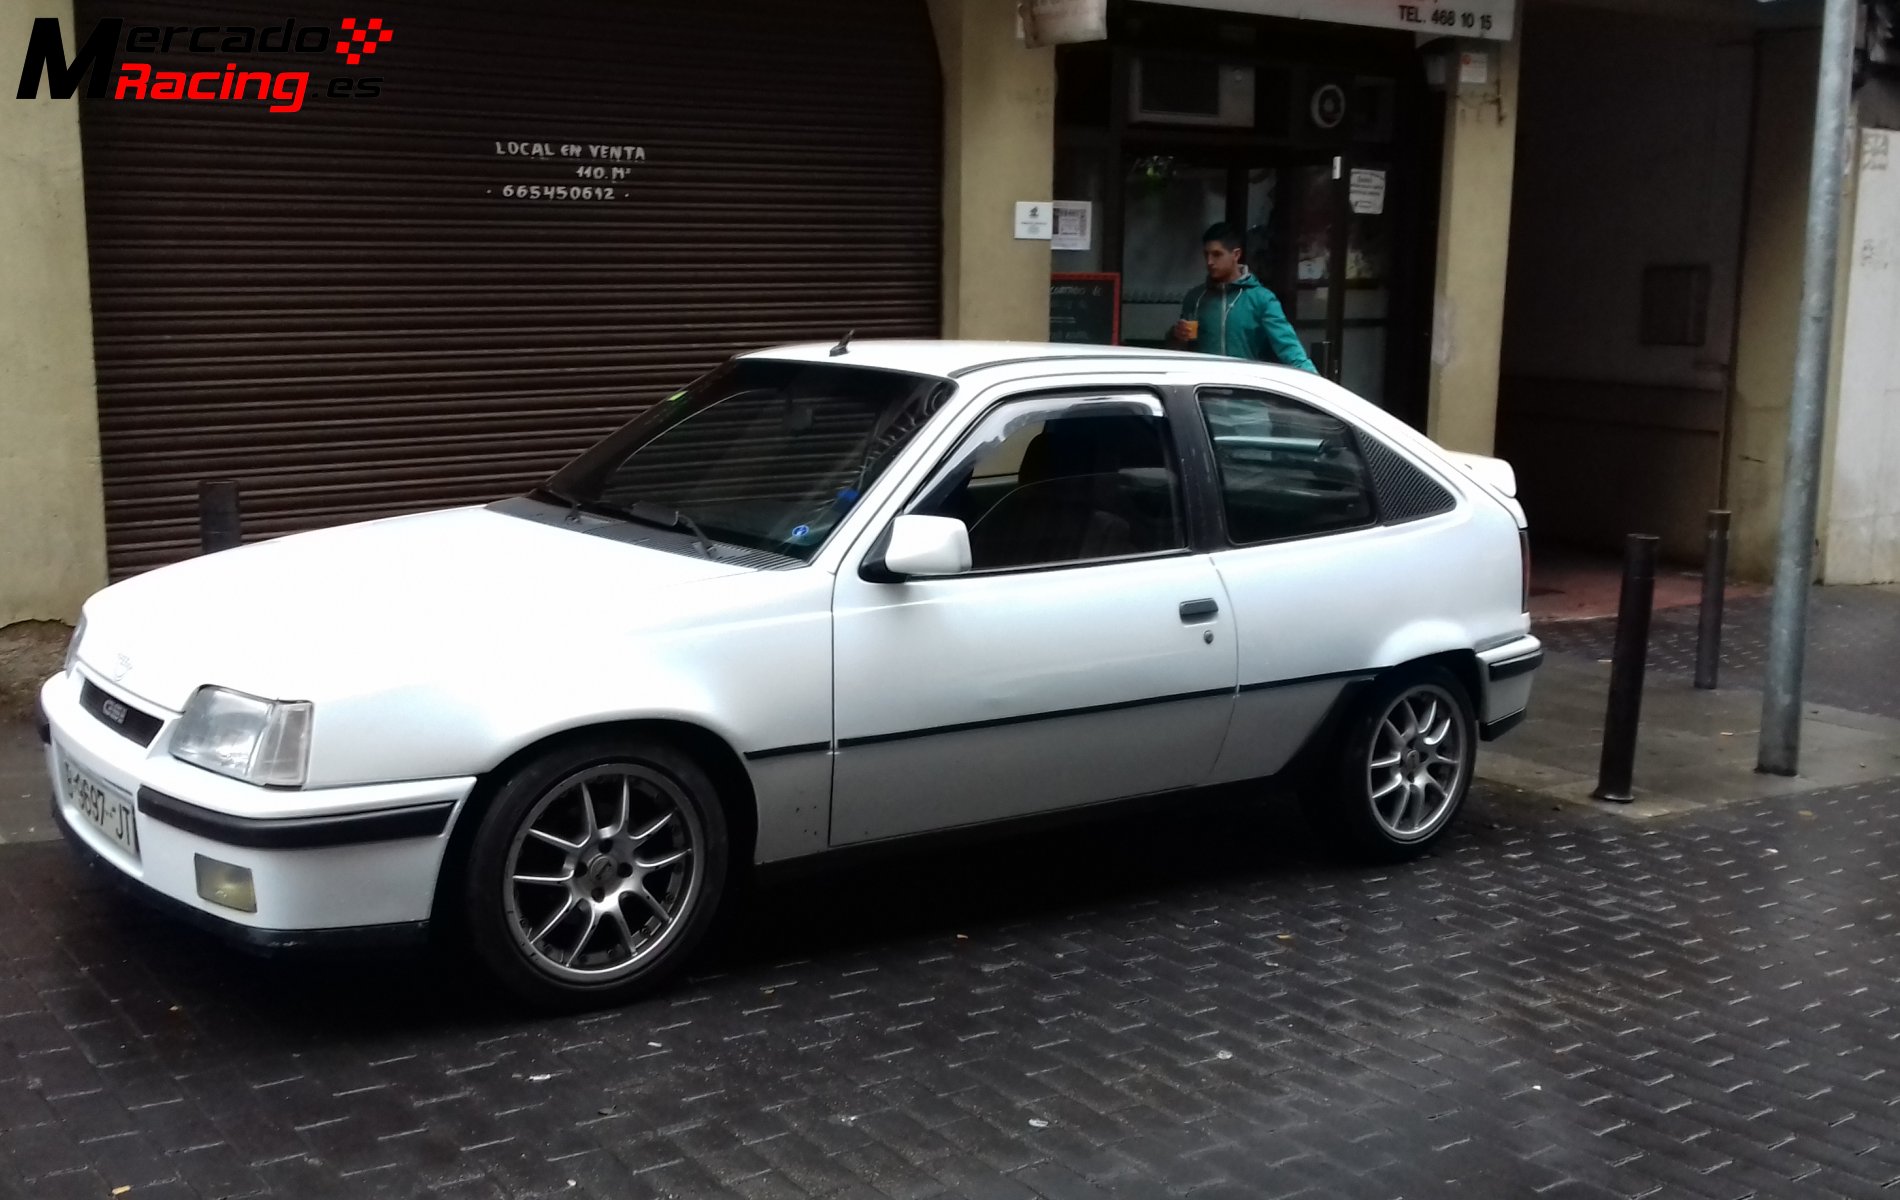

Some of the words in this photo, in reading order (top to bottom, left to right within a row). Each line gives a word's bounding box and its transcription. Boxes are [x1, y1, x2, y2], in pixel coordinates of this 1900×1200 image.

[1398, 5, 1426, 23] TEL.
[1431, 9, 1456, 26] 468
[1460, 12, 1475, 28] 10
[1479, 14, 1493, 31] 15
[495, 141, 555, 157] LOCAL
[560, 144, 582, 158] EN
[589, 145, 646, 161] VENTA
[502, 184, 615, 201] 665450612
